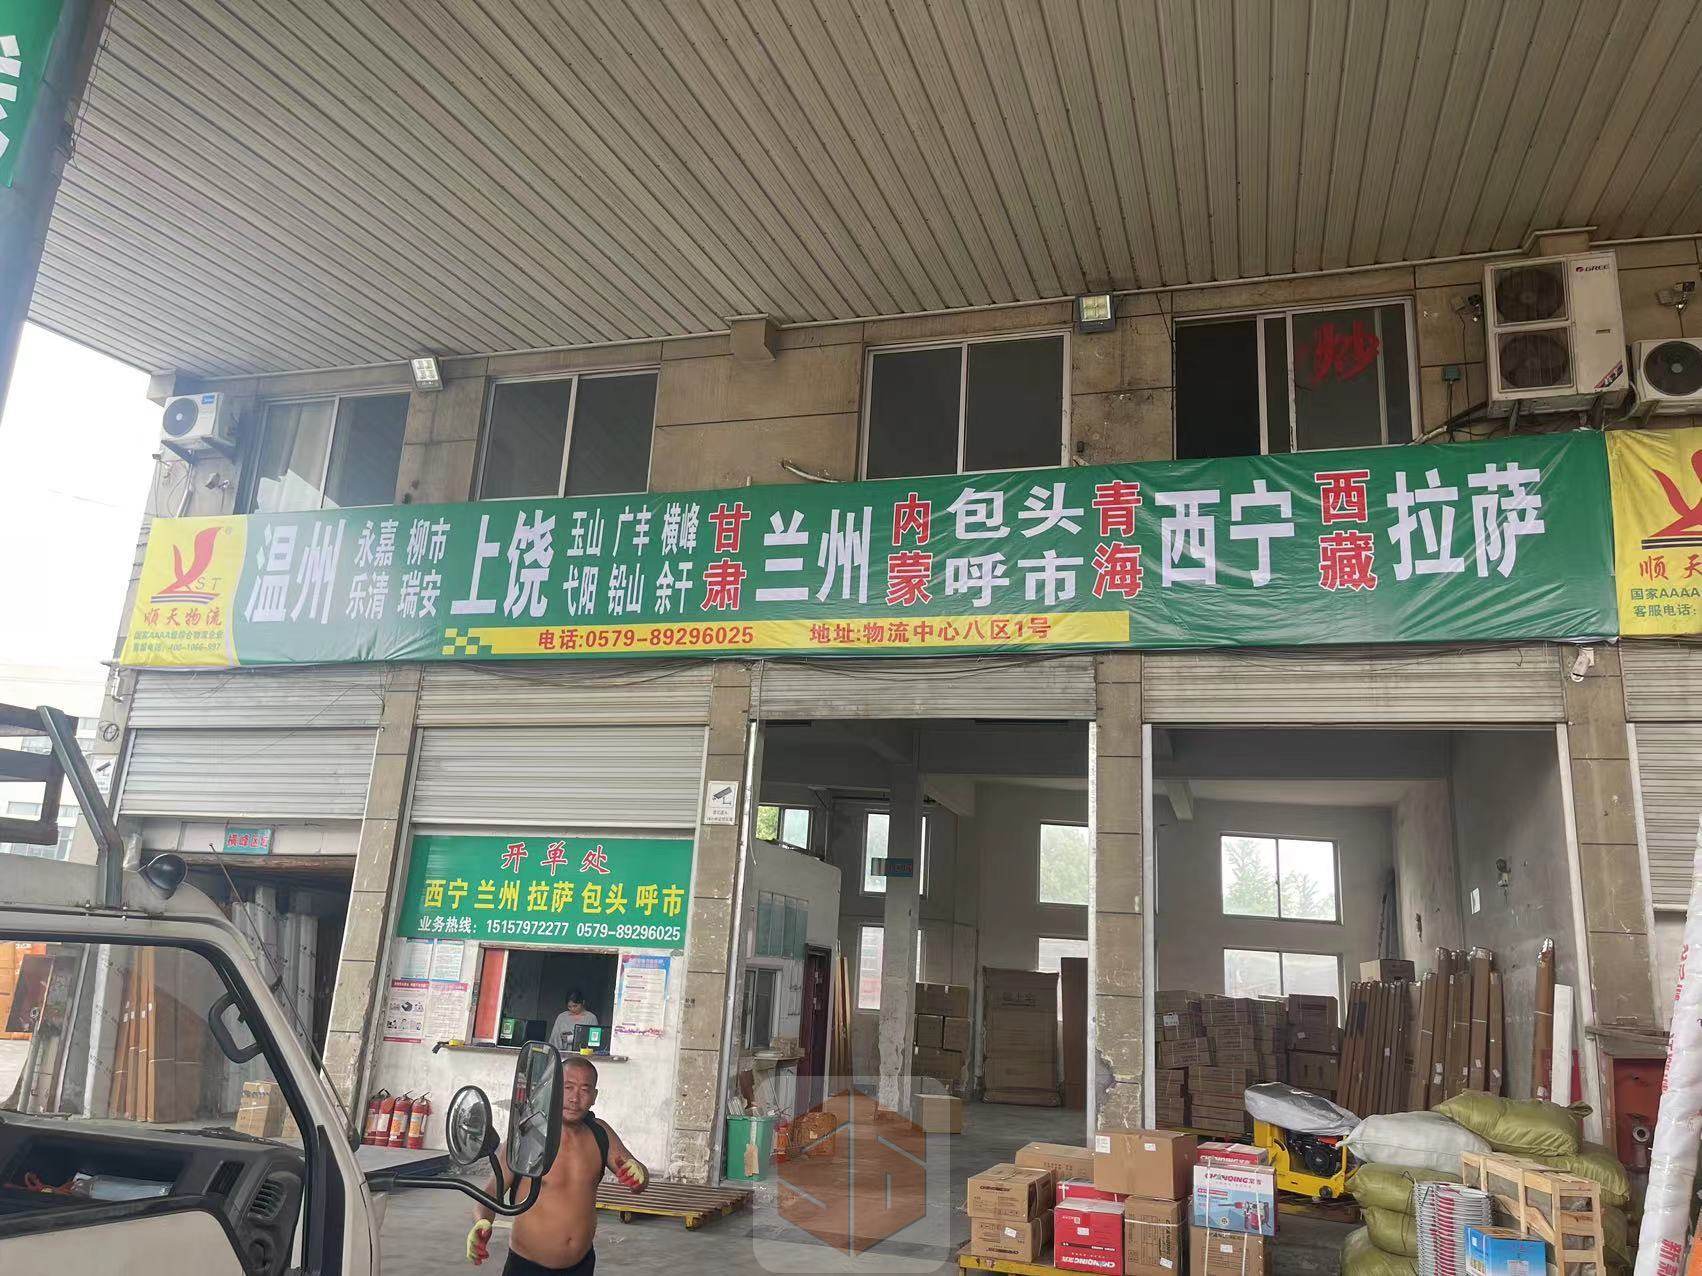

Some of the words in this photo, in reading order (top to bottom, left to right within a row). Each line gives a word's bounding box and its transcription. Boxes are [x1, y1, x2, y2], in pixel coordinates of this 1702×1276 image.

[567, 508, 604, 557] 玉山
[613, 504, 651, 557] 广丰
[662, 502, 700, 555] 横峰
[946, 482, 1084, 540] 包头
[1091, 480, 1143, 599] 青海
[1155, 479, 1294, 587] 西宁
[1315, 469, 1378, 592] 西藏
[1386, 462, 1545, 581] 拉萨
[354, 518, 398, 567] 永嘉
[407, 517, 450, 565] 柳市
[450, 509, 556, 619] 上饶
[700, 502, 751, 612] 甘肃
[755, 506, 873, 604] 兰州
[885, 492, 933, 607] 内蒙
[244, 518, 346, 624] 温州
[346, 571, 389, 619] 乐清
[397, 569, 441, 619] 瑞安
[562, 565, 599, 617] 弋阳
[608, 563, 645, 616] 铅山
[655, 561, 693, 614] 余干
[944, 550, 1084, 608] 呼市
[1631, 587, 1700, 601] 国家AAAA
[538, 626, 755, 651] 电话:0579-89296025
[810, 617, 1052, 644] 地址:物流中心八区1号
[1633, 604, 1697, 618] 客服电话:
[501, 840, 611, 876] 开单处
[424, 878, 468, 909] 西宁
[474, 879, 520, 911] 兰州
[527, 880, 575, 913] 拉萨
[581, 882, 627, 915] 包头
[636, 884, 684, 917] 呼市
[418, 915, 477, 935] 业务热线:
[486, 918, 569, 937] 15157972277
[576, 922, 681, 941] 0579-89296025
